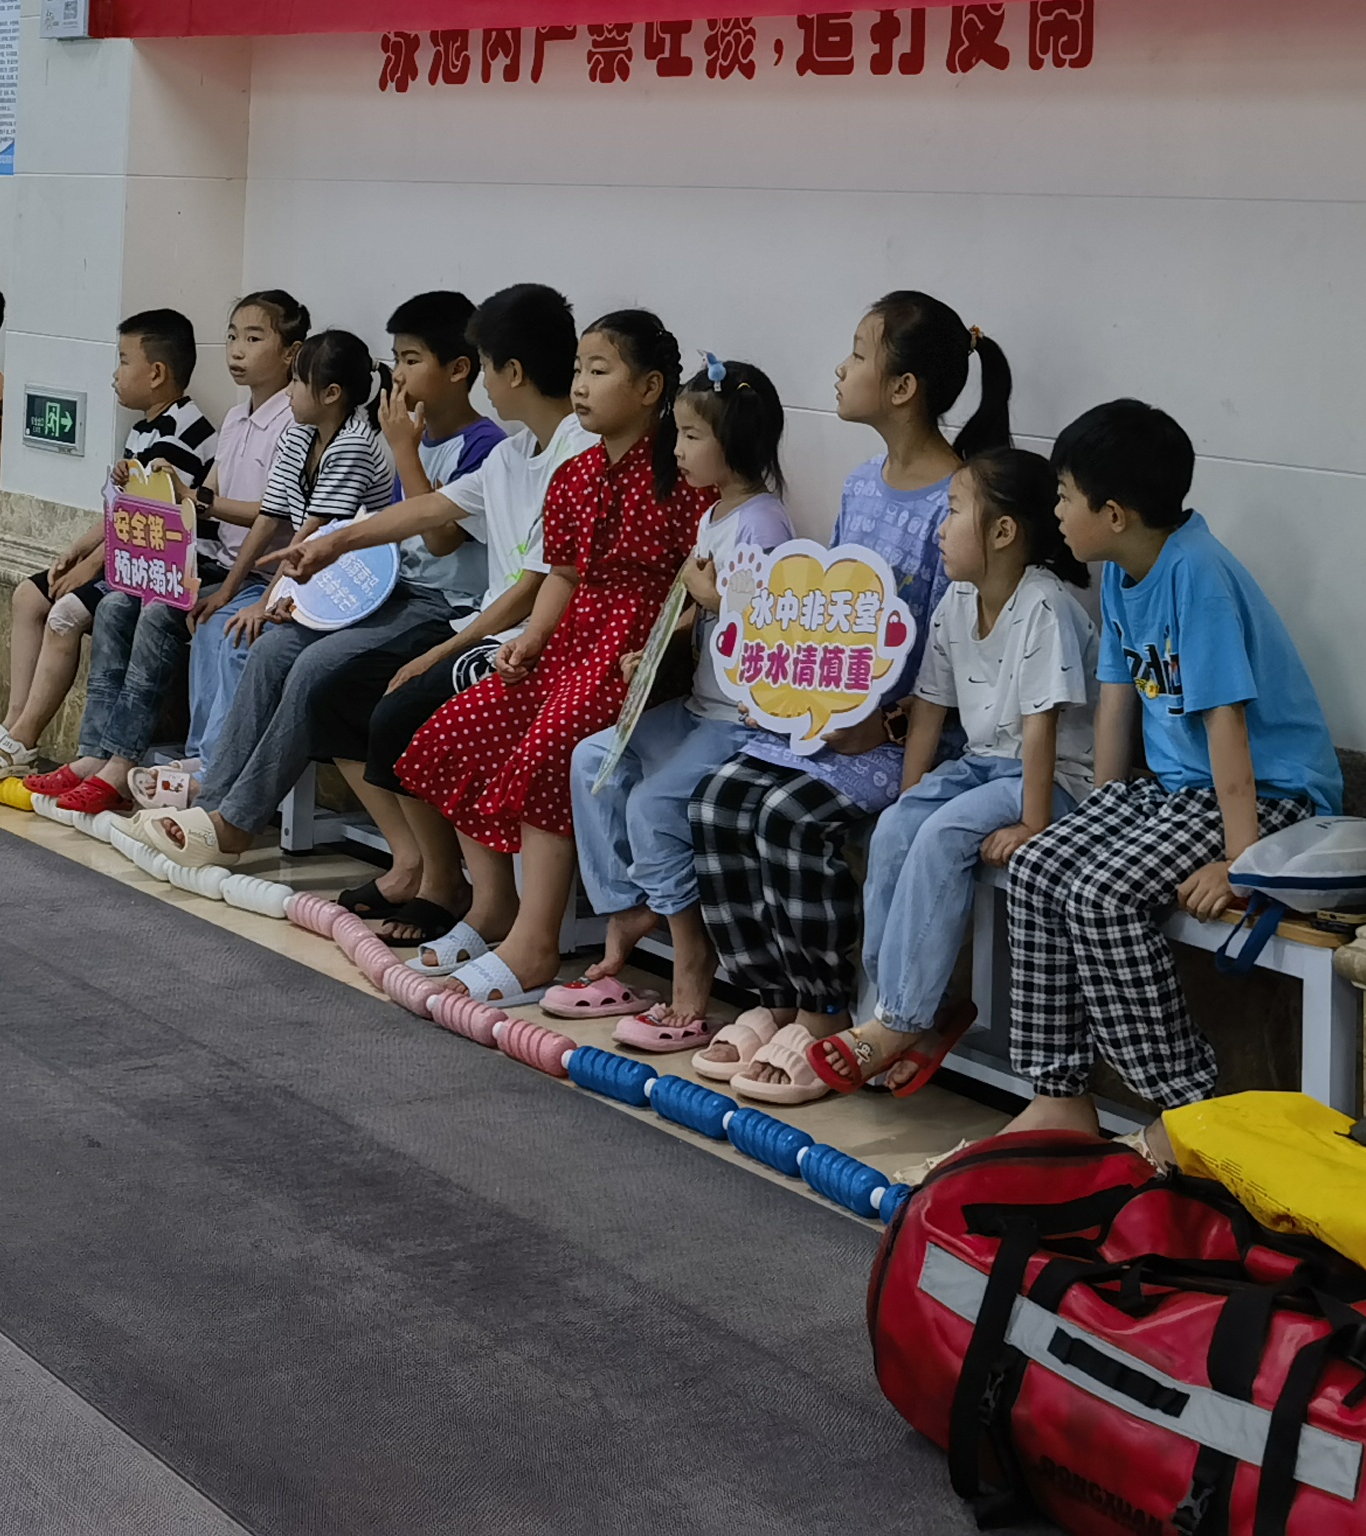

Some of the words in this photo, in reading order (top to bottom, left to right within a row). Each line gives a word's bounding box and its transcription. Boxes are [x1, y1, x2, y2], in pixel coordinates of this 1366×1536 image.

[113, 507, 183, 551] 安全第一
[114, 548, 184, 598] 预防溺水
[748, 587, 881, 634] 水中非天堂
[739, 641, 874, 692] 涉水请慎重
